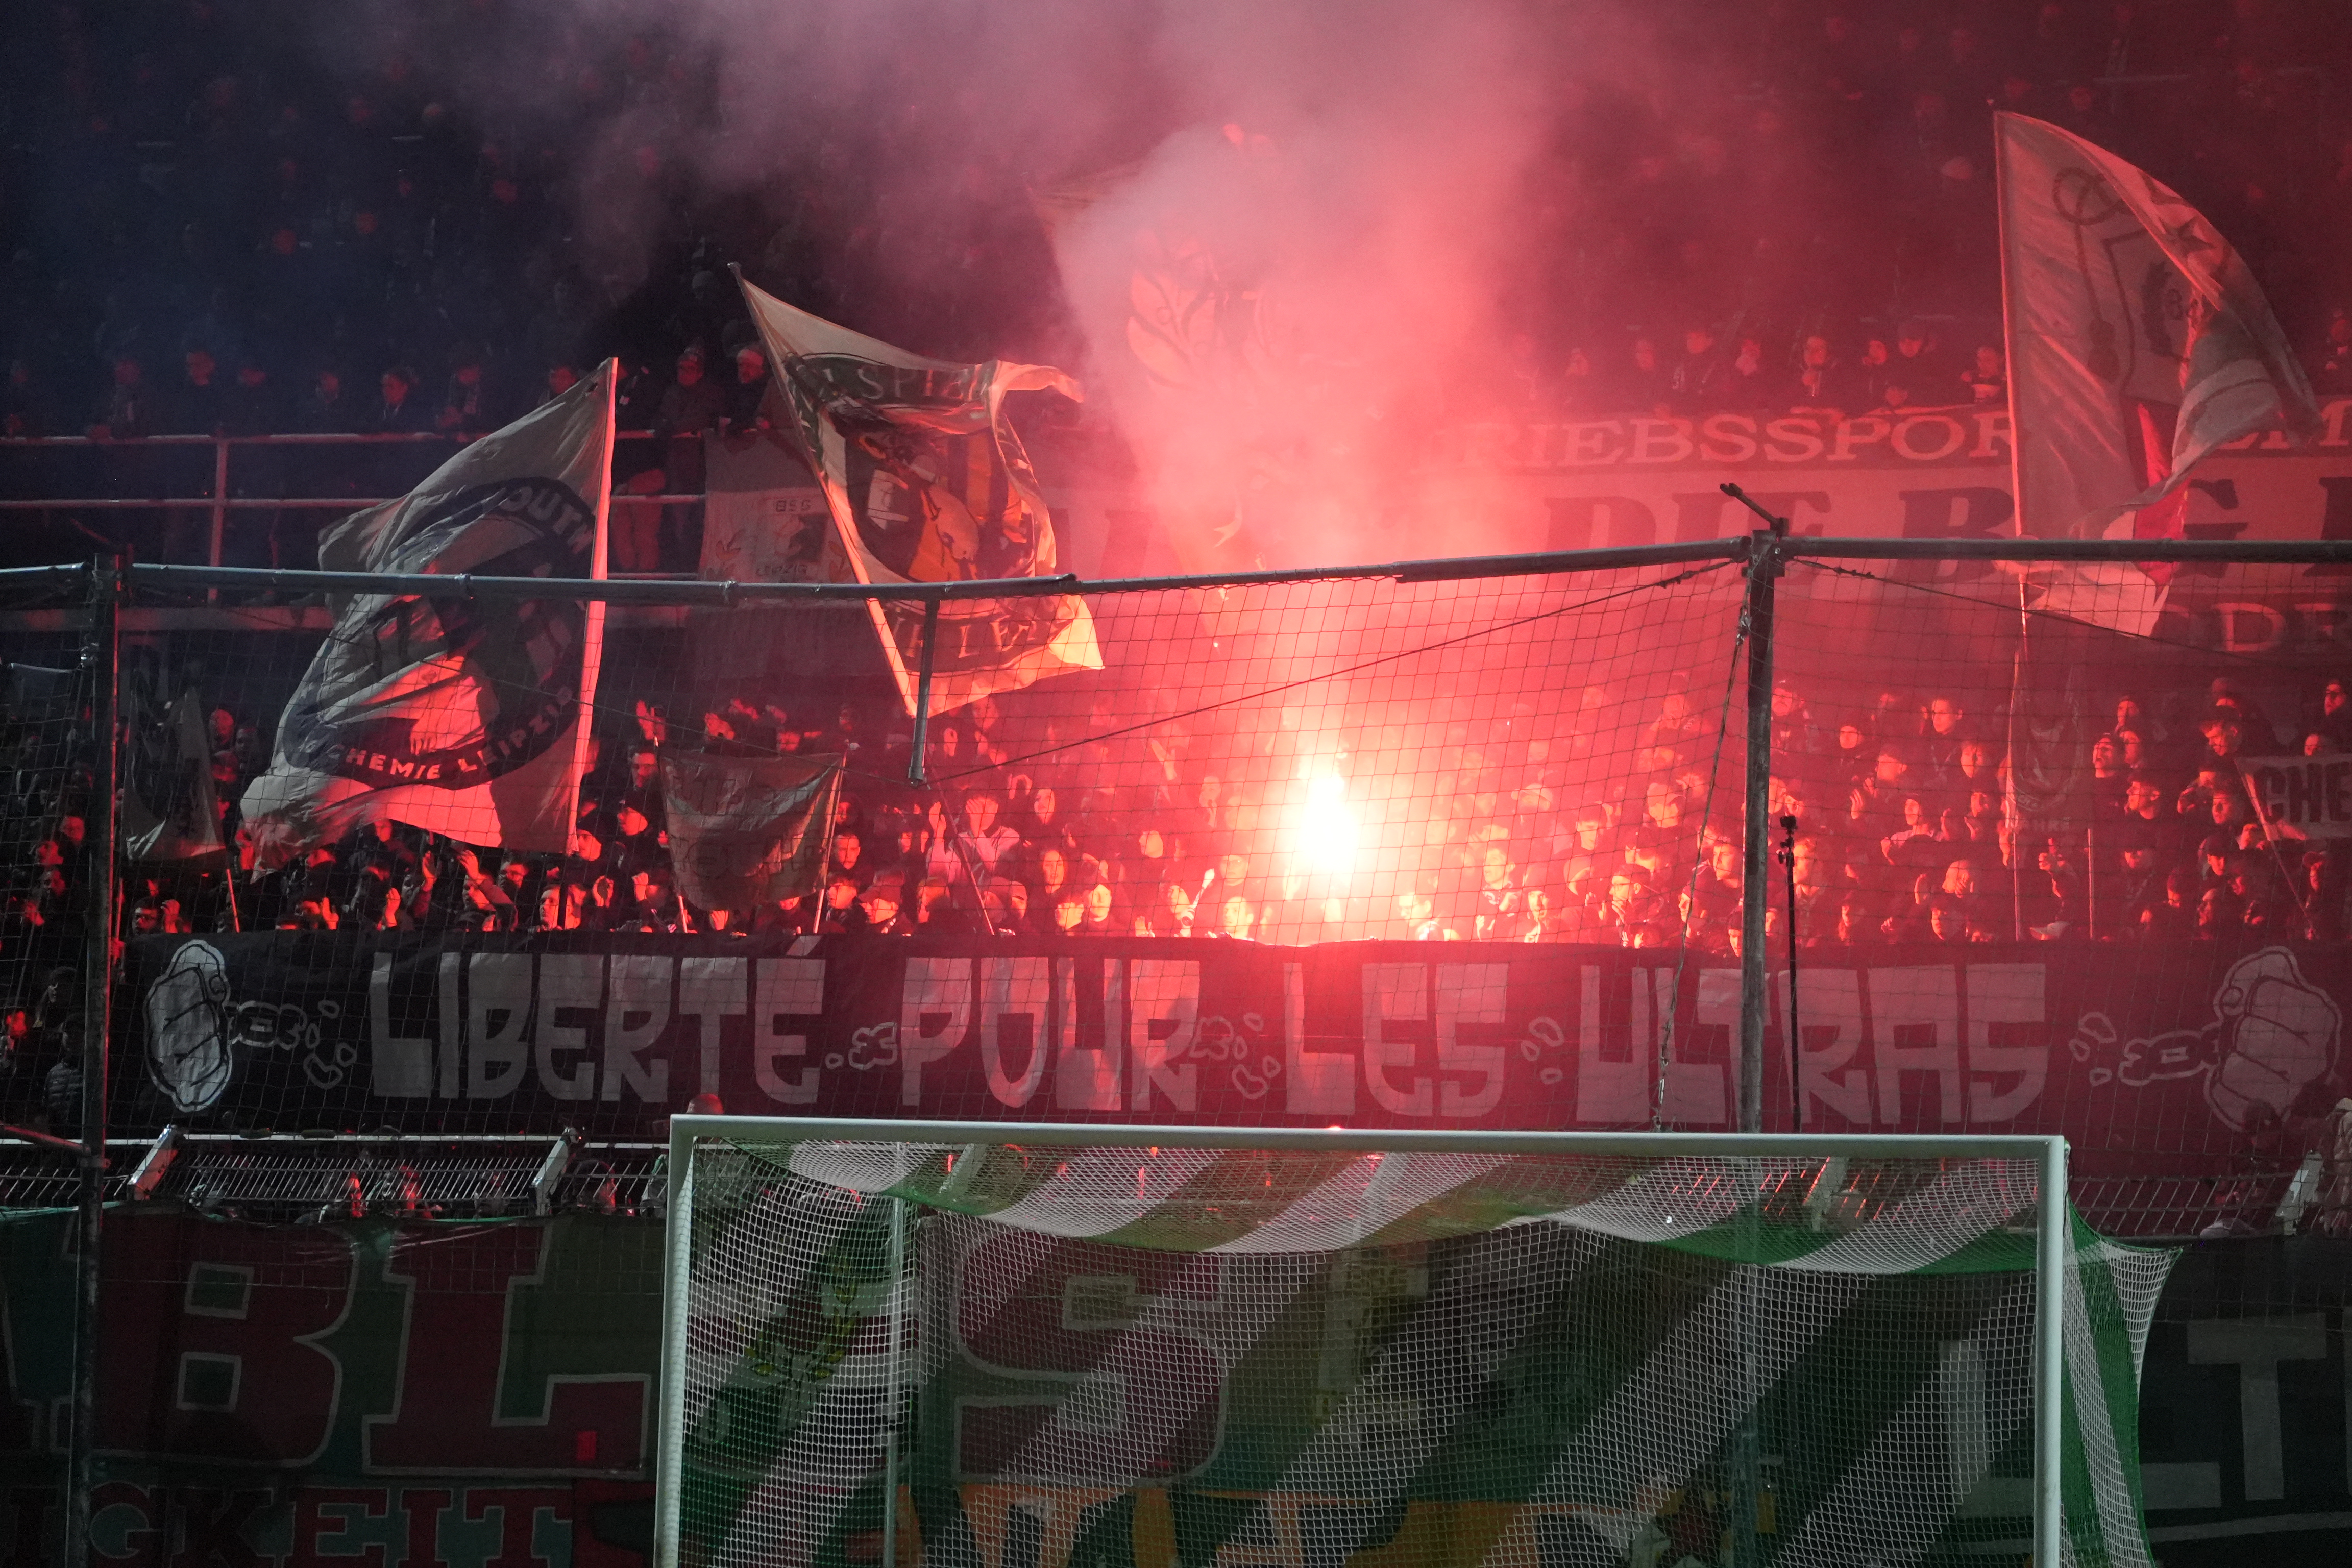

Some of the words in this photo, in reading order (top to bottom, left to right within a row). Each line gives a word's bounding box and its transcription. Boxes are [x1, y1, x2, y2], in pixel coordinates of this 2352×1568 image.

[776, 499, 811, 512] BSG
[325, 743, 442, 780] CHEMIE
[369, 935, 826, 1105] LIBERTÉ
[902, 956, 1200, 1112] POUR
[1283, 961, 1509, 1117] LES
[1576, 962, 2047, 1125] ULTRAS
